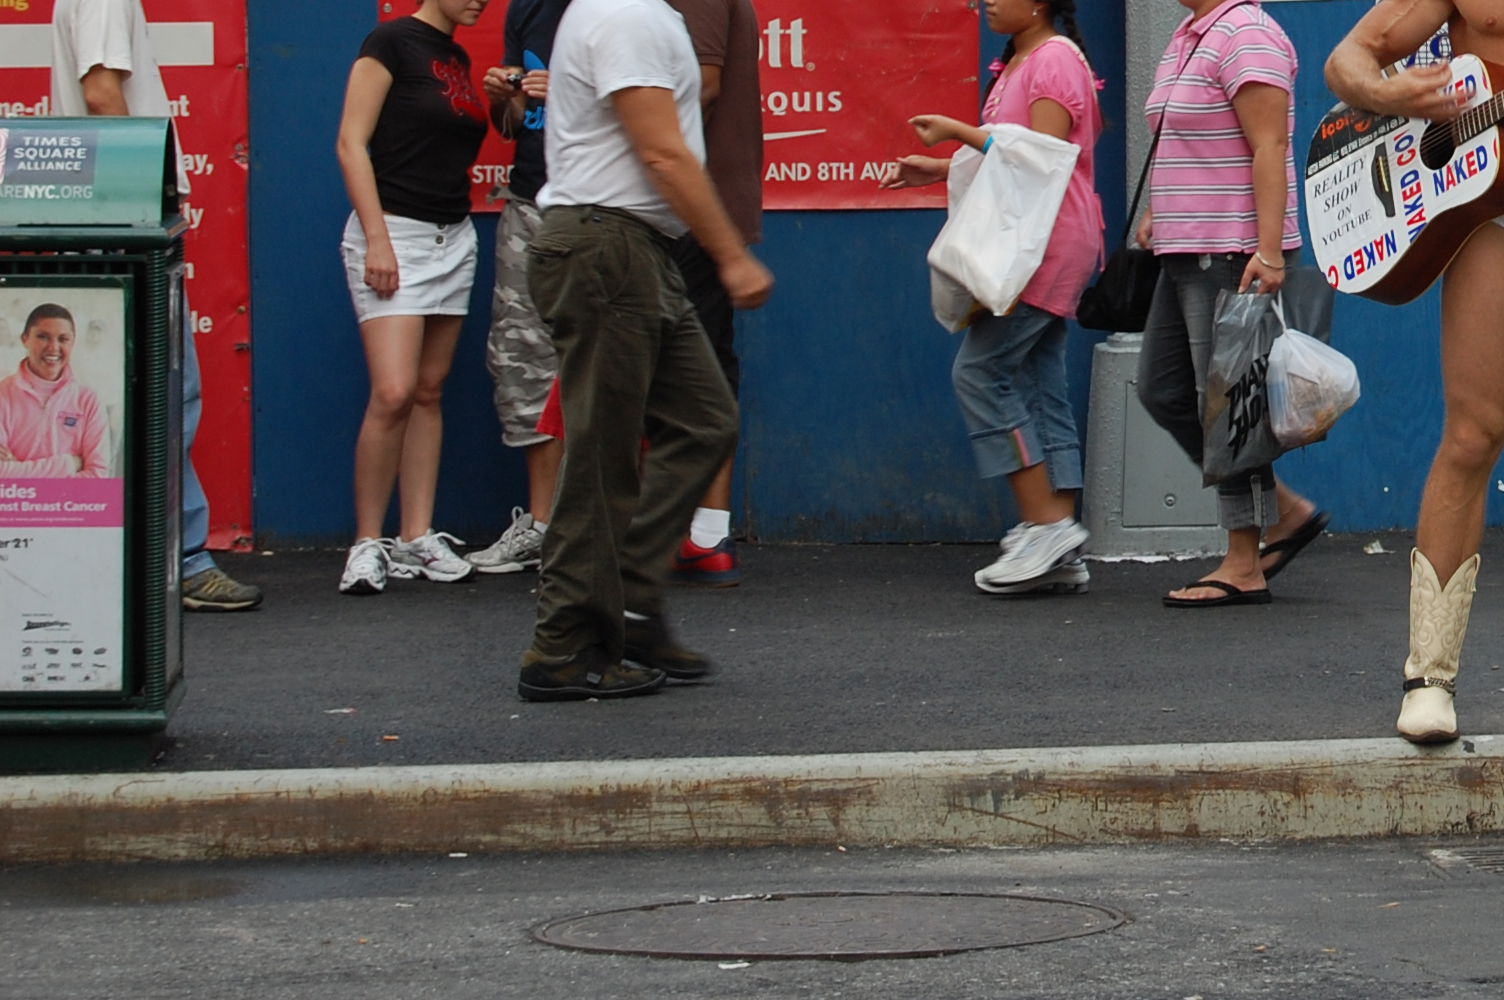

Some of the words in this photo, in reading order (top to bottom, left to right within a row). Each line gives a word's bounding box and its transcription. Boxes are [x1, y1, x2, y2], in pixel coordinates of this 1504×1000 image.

[761, 89, 843, 116] QUIS
[14, 147, 88, 160] SQUARE
[23, 136, 82, 147] TIMES
[17, 160, 82, 171] ALLIANCE
[765, 162, 811, 182] AND
[817, 161, 855, 181] 8TH
[1314, 154, 1367, 199] REALITY
[1433, 145, 1488, 197] NAKED
[1323, 178, 1362, 214] SHOW
[1321, 209, 1373, 247] YOUTUBE
[1343, 229, 1398, 281] NAKED
[21, 501, 61, 513] Breast
[63, 501, 108, 513] Cancer
